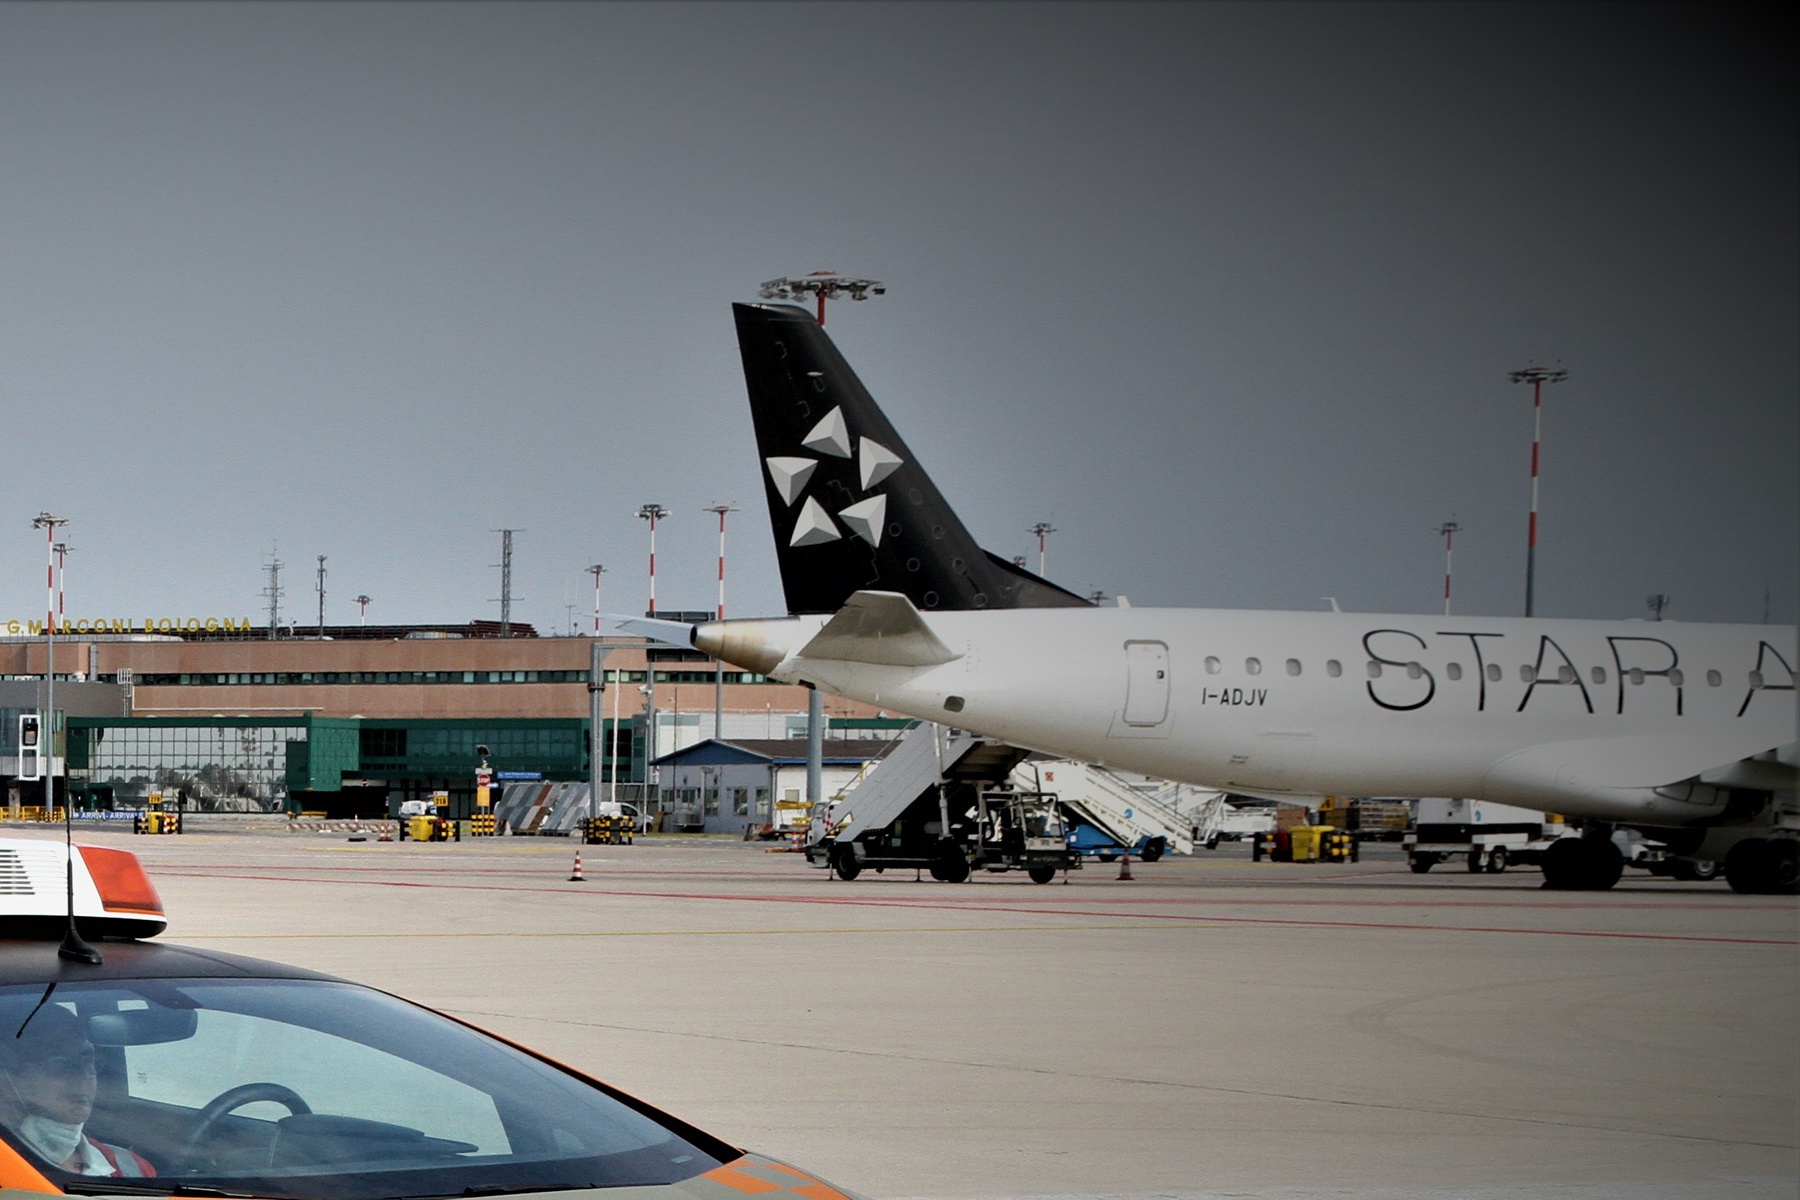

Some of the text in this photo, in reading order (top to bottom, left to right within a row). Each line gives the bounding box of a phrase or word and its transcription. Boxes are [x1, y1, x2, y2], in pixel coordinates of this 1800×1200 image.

[144, 617, 251, 633] BOLOGNA
[1362, 629, 1684, 717] STAR
[1201, 687, 1268, 706] I-ADJV
